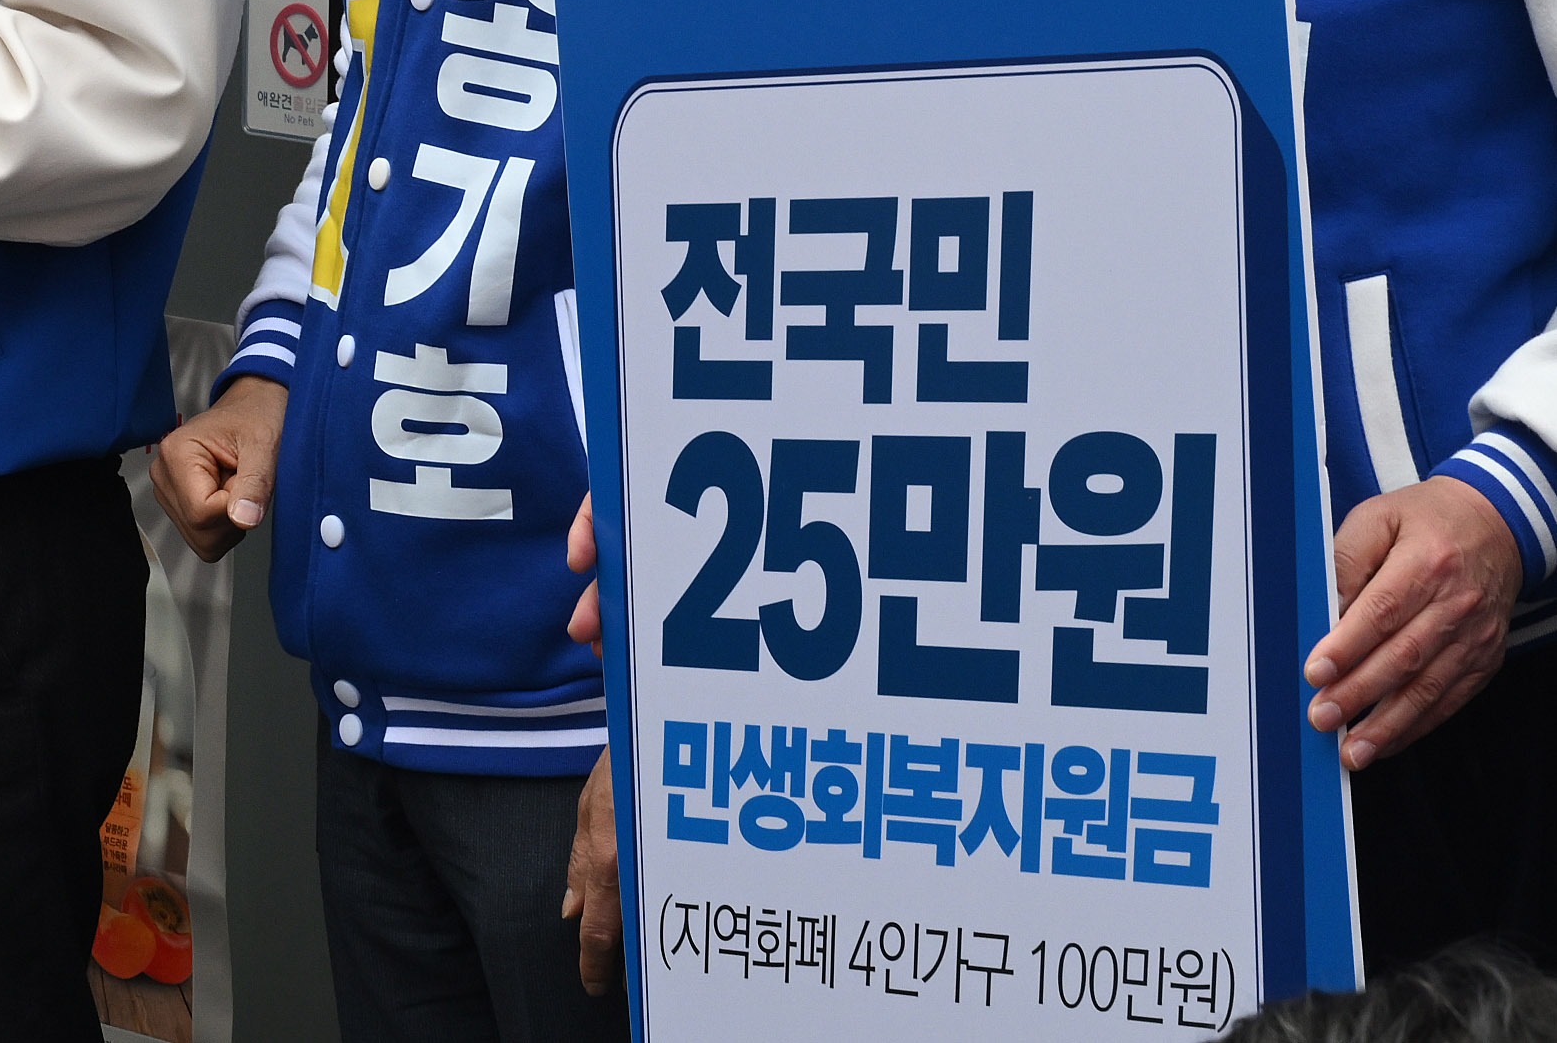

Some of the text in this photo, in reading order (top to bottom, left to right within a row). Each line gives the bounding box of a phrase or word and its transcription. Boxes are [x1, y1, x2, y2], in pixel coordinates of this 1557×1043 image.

[284, 113, 296, 125] No
[660, 189, 1034, 405] 전국민
[661, 430, 1218, 715] 25만원
[662, 719, 1220, 889] 민생회복지원금
[659, 892, 1236, 1034] (지역화폐 4인가구 100만원)
